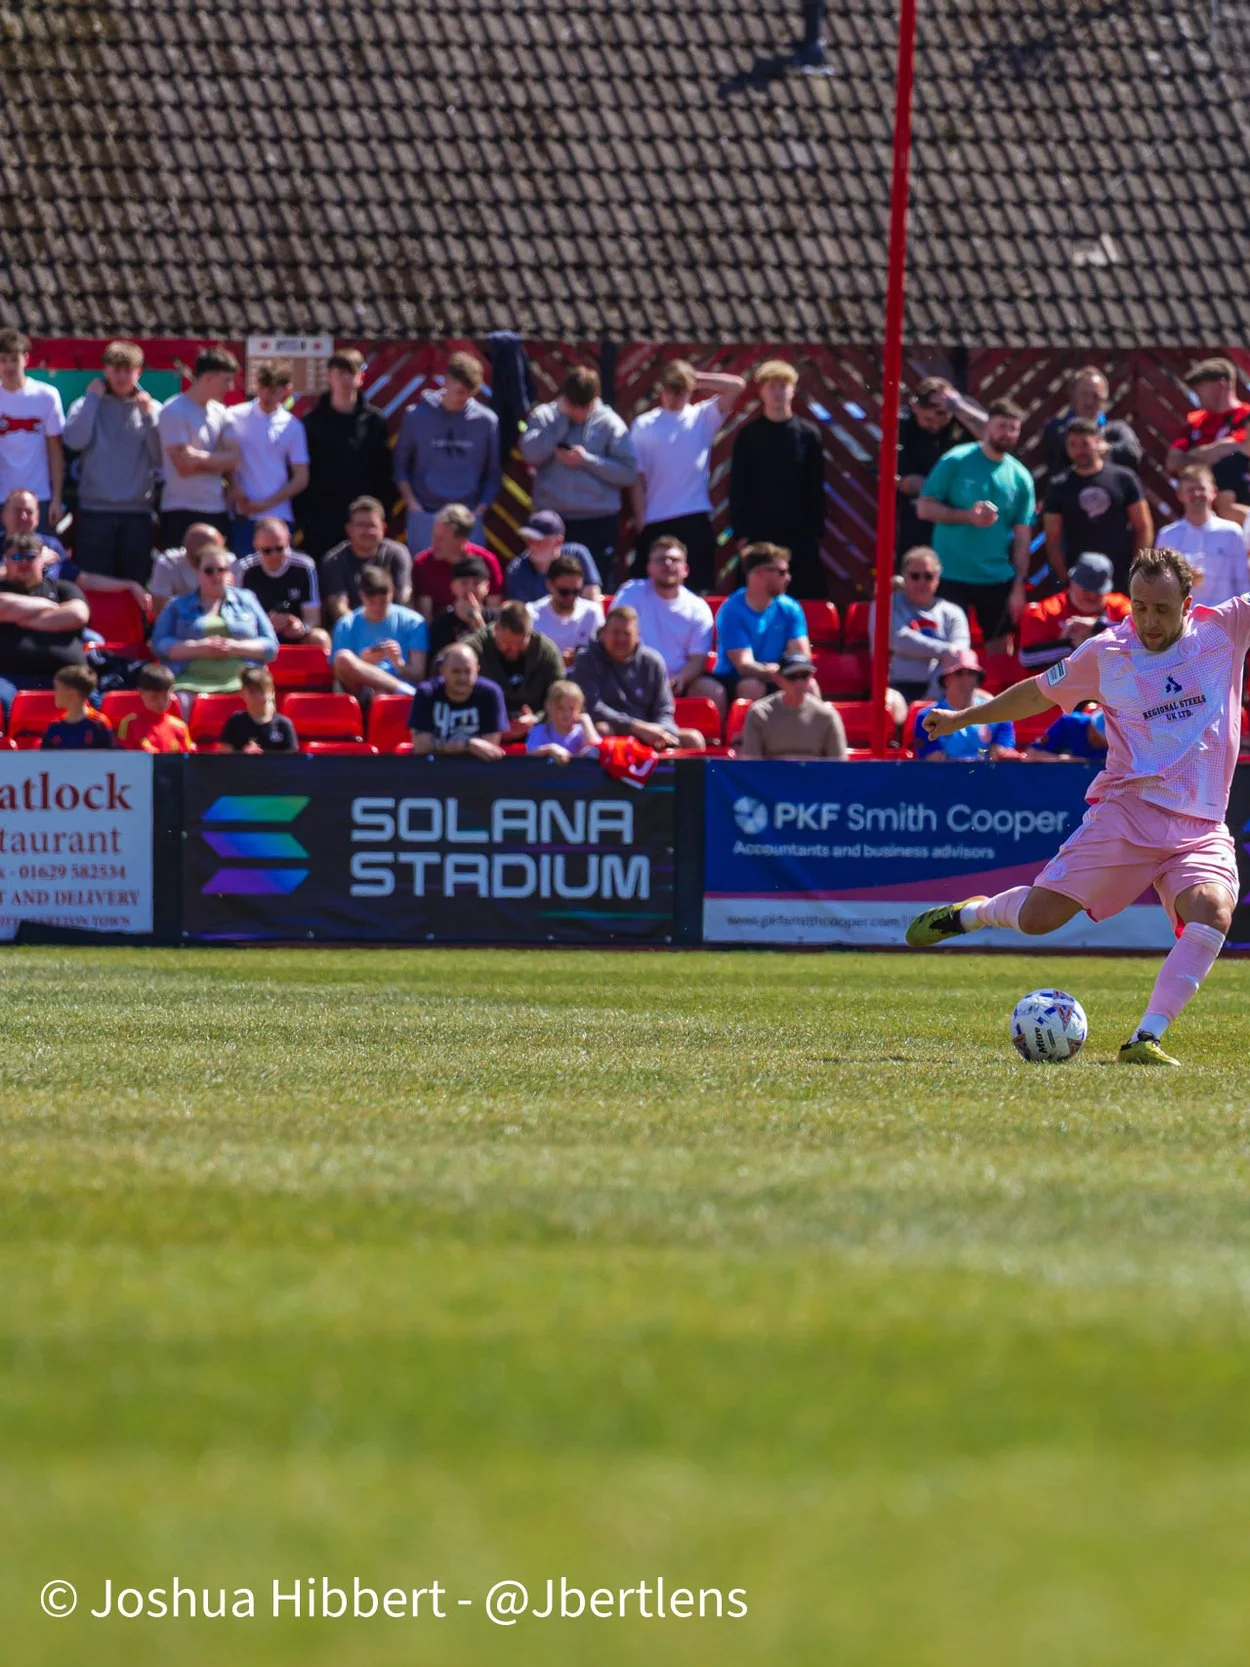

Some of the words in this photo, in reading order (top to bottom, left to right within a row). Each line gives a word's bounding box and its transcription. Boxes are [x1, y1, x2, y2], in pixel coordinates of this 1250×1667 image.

[1142, 702, 1179, 720] REGIONAL
[1179, 695, 1206, 708] STEELS
[1165, 712, 1177, 721] UK
[351, 797, 633, 844] SOLANA
[774, 802, 840, 831] PKF
[848, 802, 937, 832] Smith
[947, 803, 1069, 841] Cooper
[733, 840, 829, 857] Accountants
[833, 844, 861, 858] and
[863, 843, 929, 859] business
[931, 844, 996, 860] advisors
[350, 852, 650, 899] STADIUM
[12, 889, 49, 906] AND
[53, 889, 139, 907] DELIVERY
